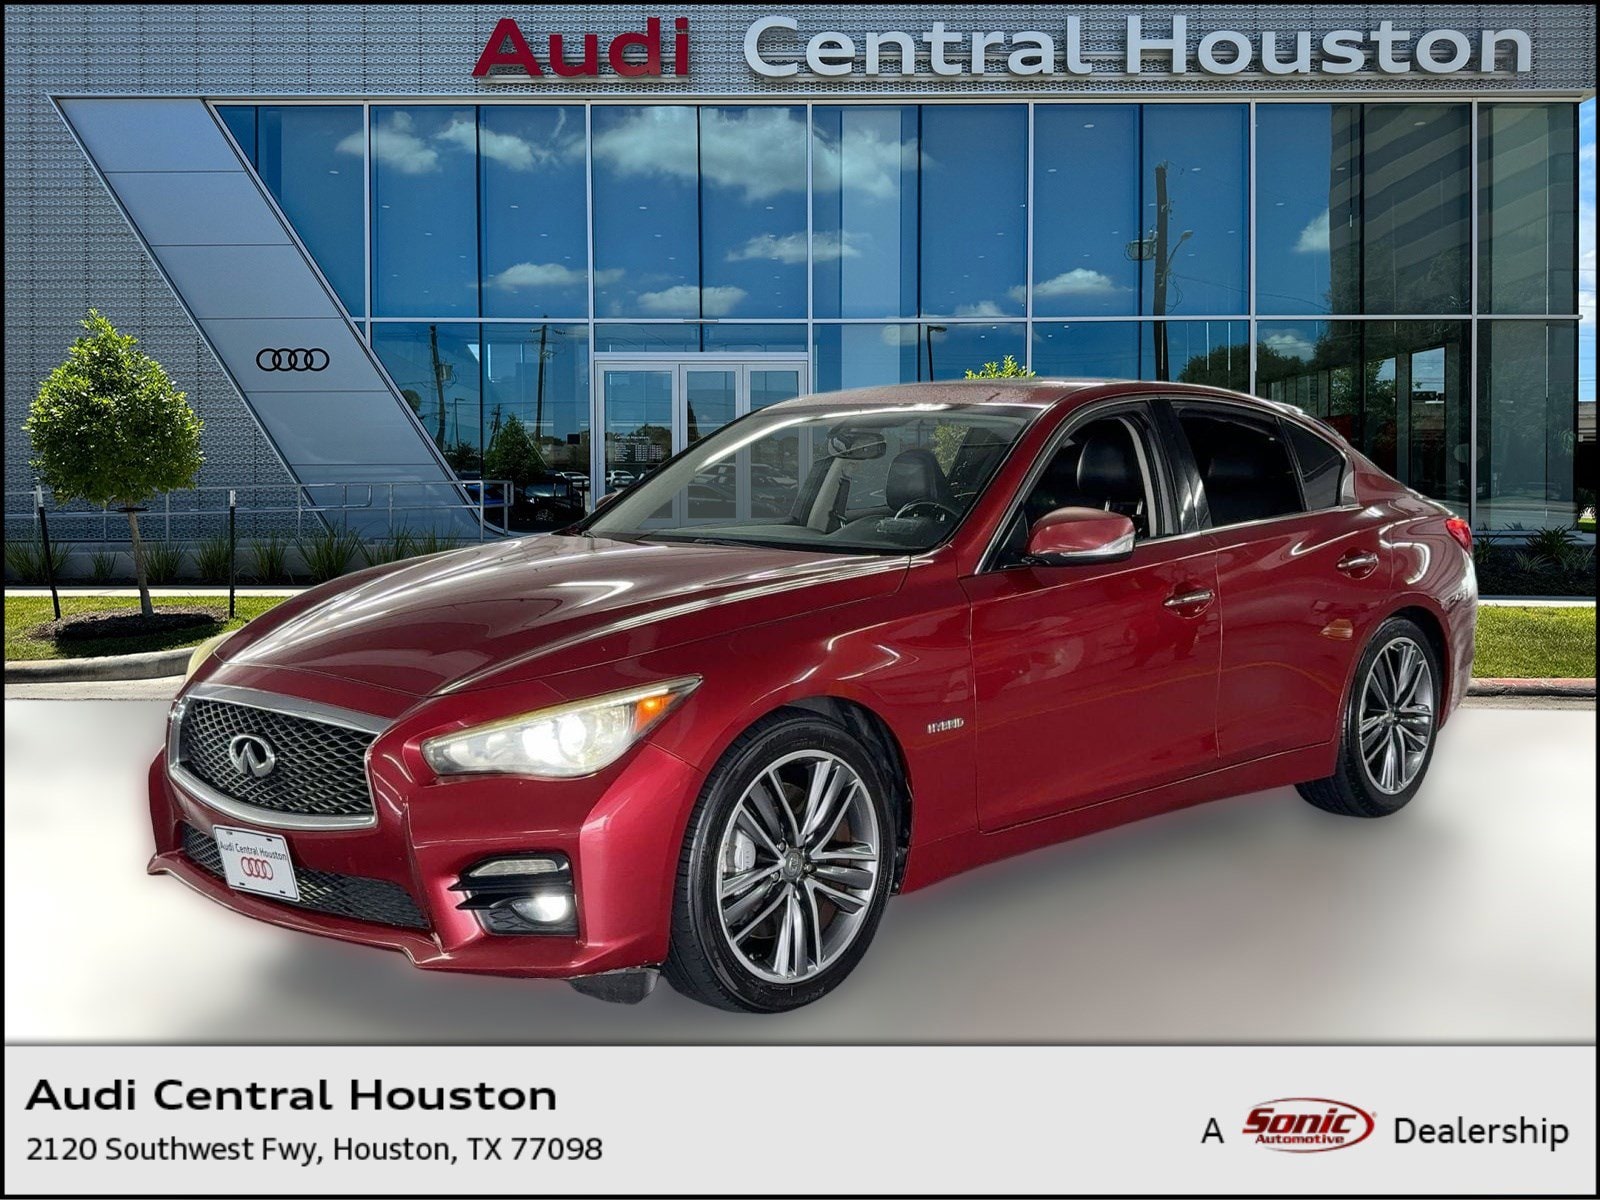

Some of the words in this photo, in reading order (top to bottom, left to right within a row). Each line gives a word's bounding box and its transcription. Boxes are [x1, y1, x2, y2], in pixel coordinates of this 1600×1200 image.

[471, 17, 689, 77] Audi
[744, 15, 1092, 77] Central
[1126, 15, 1532, 75] Houston
[927, 717, 965, 734] HYBRID
[219, 841, 235, 852] Audi
[235, 843, 260, 856] Central
[260, 848, 288, 861] Houston
